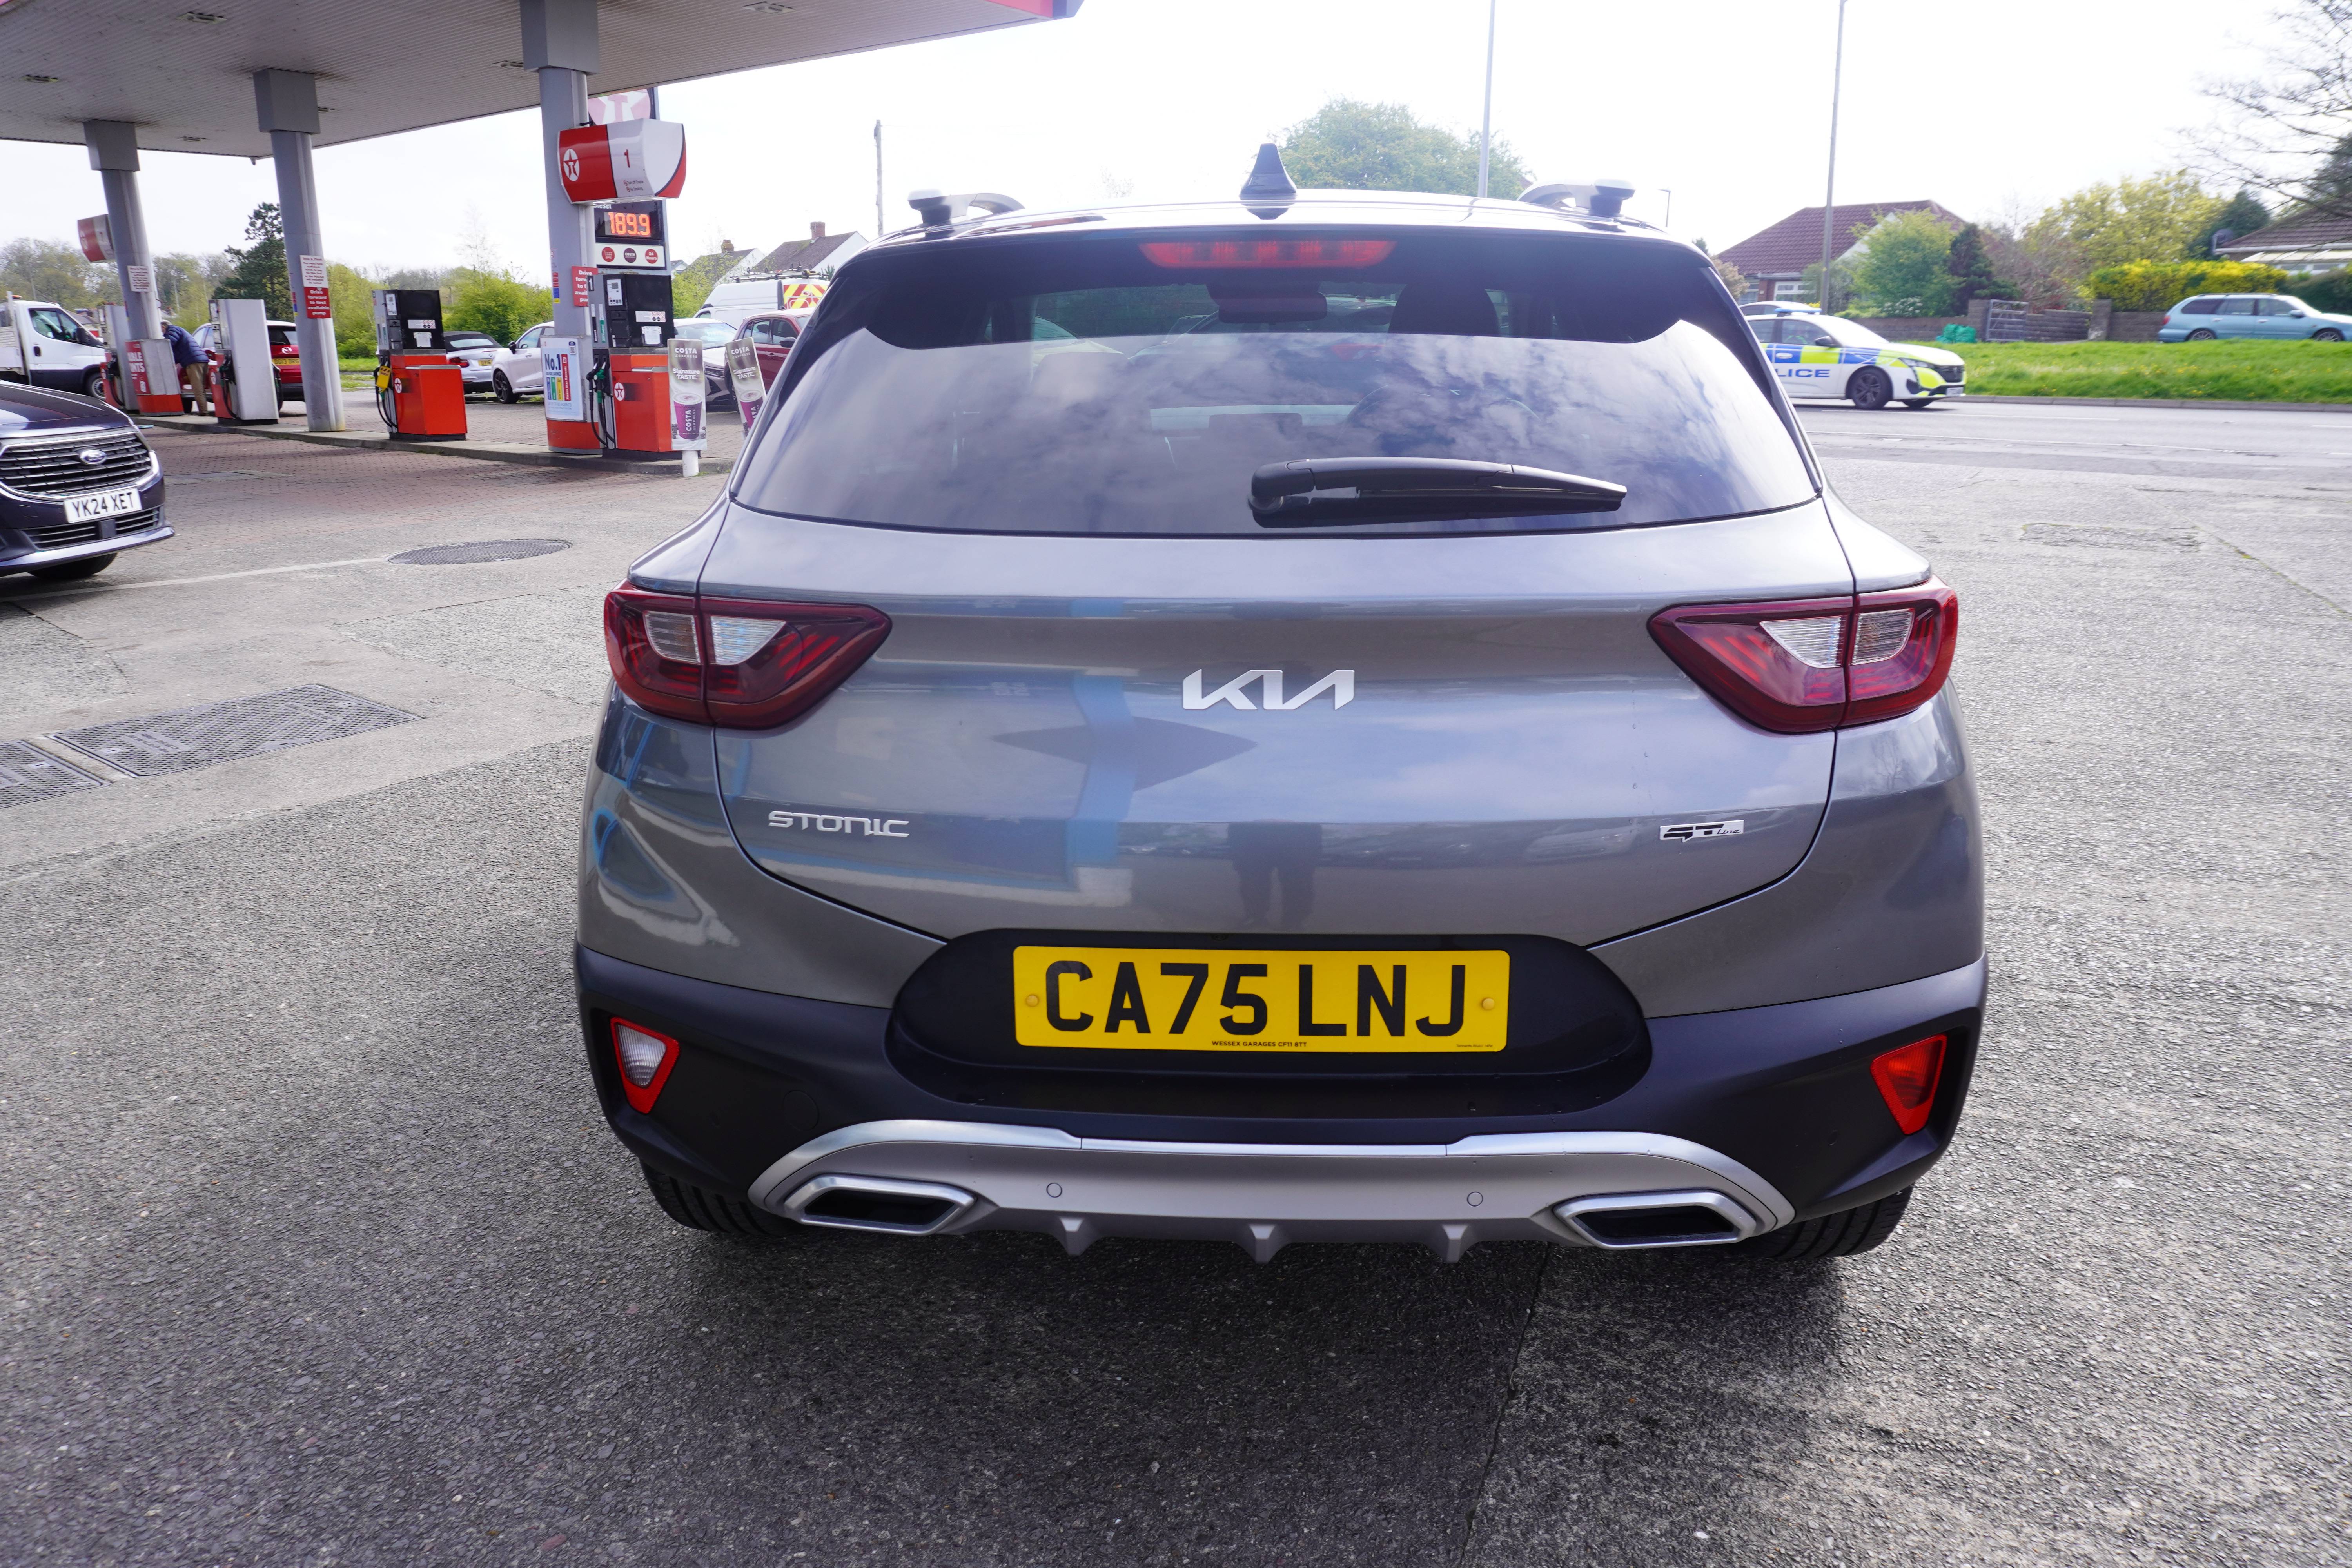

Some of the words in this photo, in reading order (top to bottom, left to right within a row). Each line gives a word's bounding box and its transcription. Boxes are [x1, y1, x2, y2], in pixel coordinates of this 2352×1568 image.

[624, 149, 630, 168] 1
[608, 212, 651, 236] 189.9
[589, 278, 593, 290] 1
[731, 346, 750, 355] COSTA
[544, 354, 561, 370] No.1
[733, 367, 756, 375] Signature
[1775, 369, 1830, 377] LICE
[72, 499, 108, 518] YK24
[111, 492, 134, 512] XET
[1183, 669, 1355, 710] KIA
[768, 811, 909, 837] STONIC
[1045, 960, 1268, 1035] CA75
[1299, 964, 1466, 1037] LNJ
